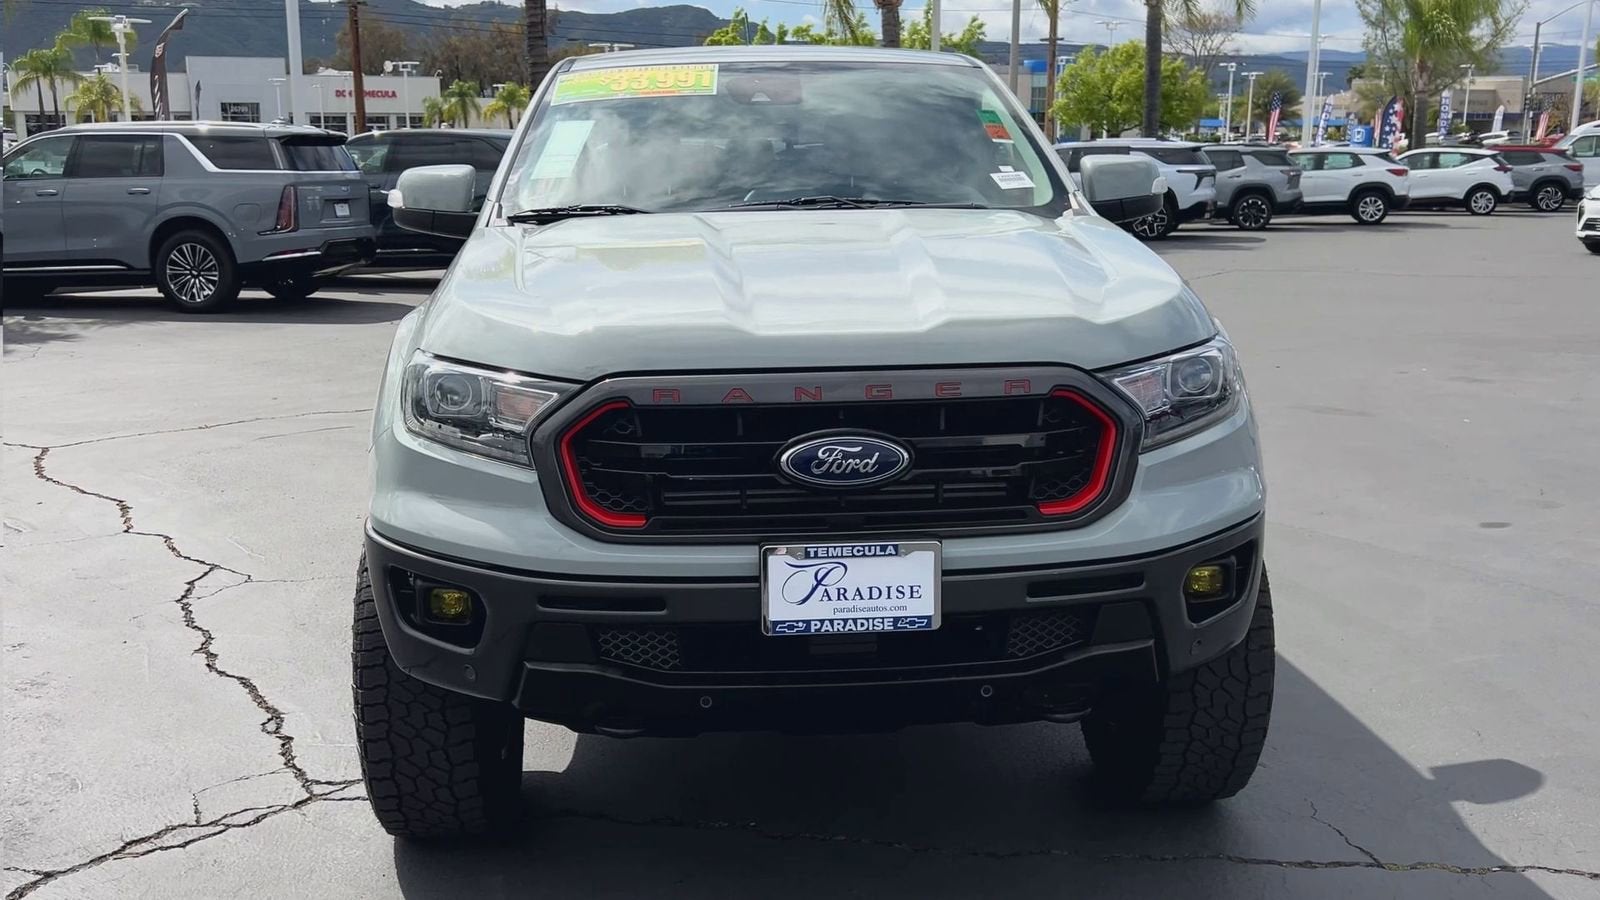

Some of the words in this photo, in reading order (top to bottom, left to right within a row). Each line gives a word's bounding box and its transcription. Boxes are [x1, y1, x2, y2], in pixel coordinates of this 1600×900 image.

[363, 89, 397, 98] MECULA
[1440, 97, 1450, 134] HONDA
[652, 379, 1031, 402] RANGER
[811, 446, 879, 474] Ford
[807, 545, 897, 557] TEMECULA
[782, 561, 922, 605] PARADISE
[832, 604, 908, 615] paradiseautos.com
[810, 618, 894, 632] PARADISE
